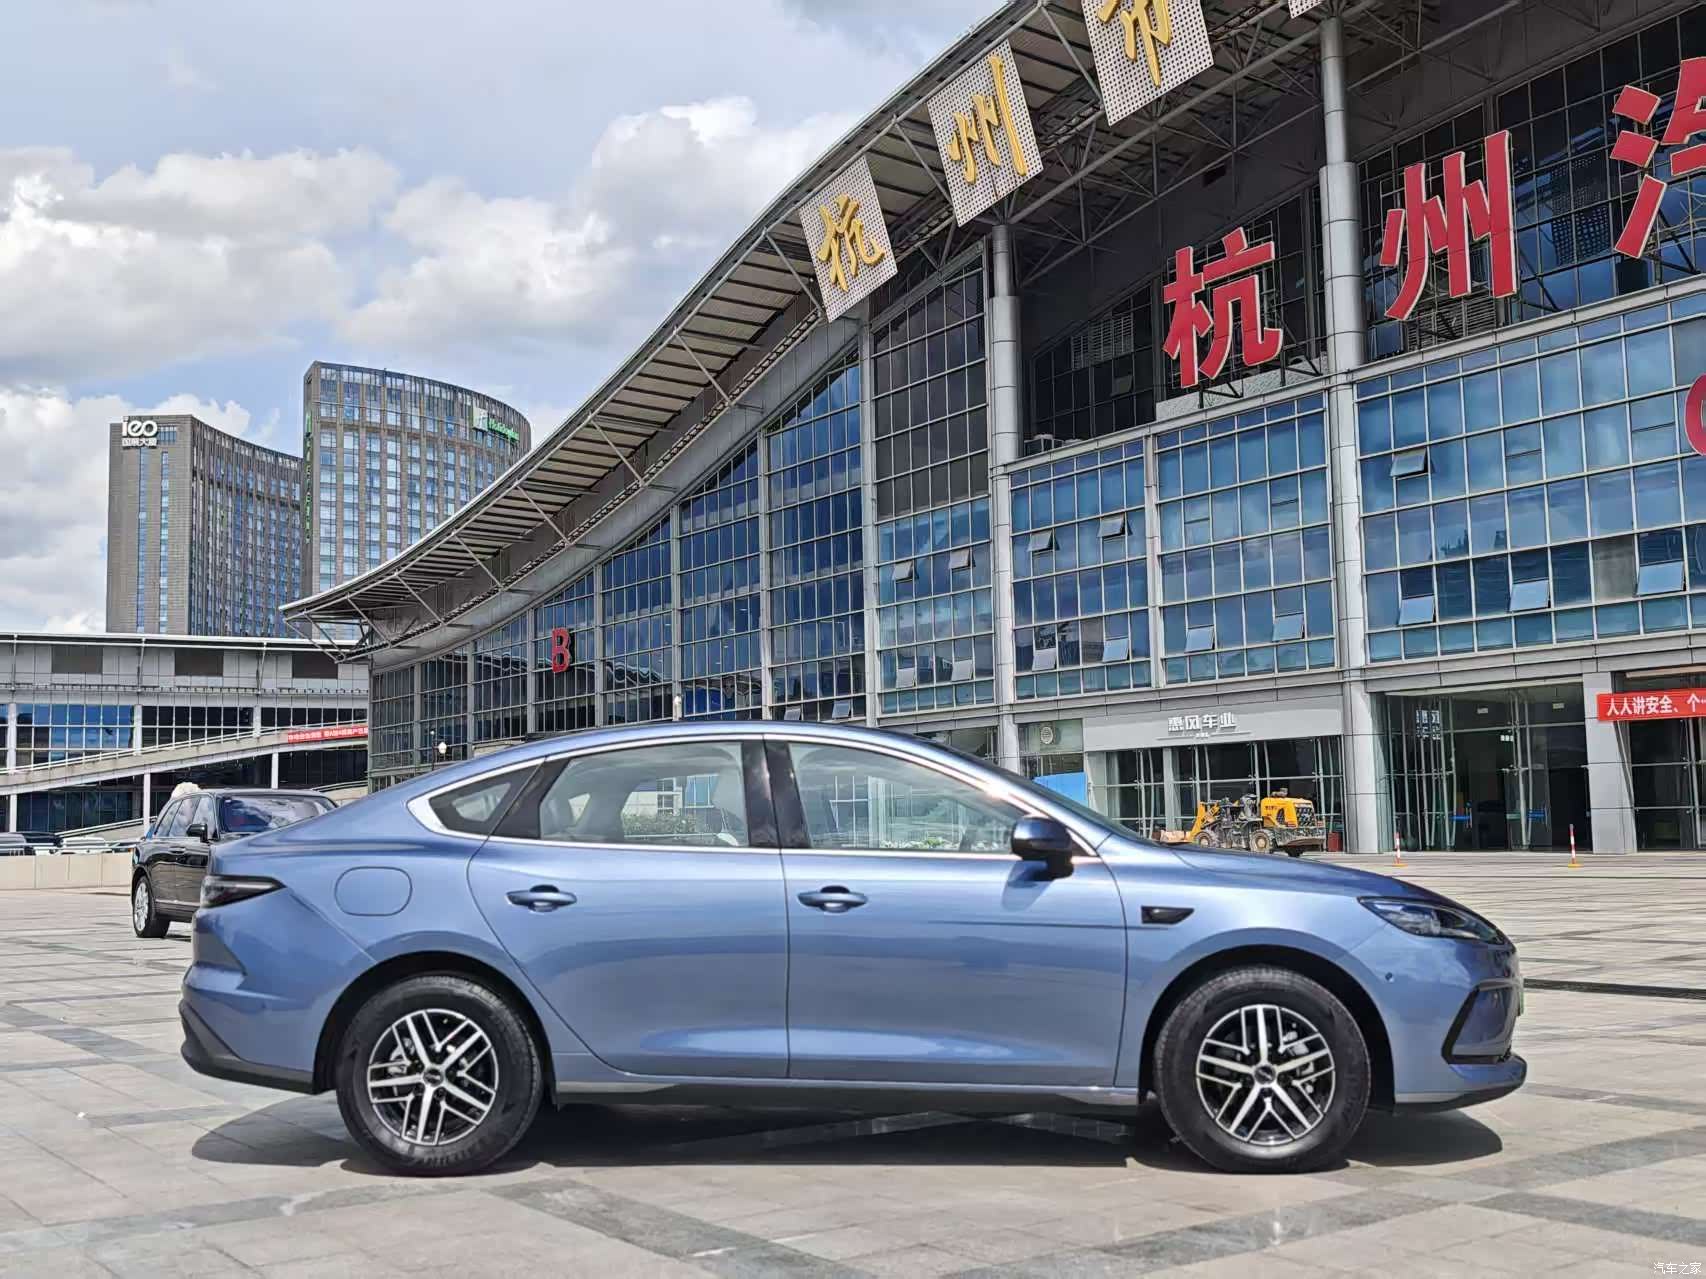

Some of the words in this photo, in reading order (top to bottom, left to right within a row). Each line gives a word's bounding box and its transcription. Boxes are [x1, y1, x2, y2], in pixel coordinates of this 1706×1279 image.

[552, 627, 572, 673] B
[1607, 692, 1706, 717] 人人讲安全、个
